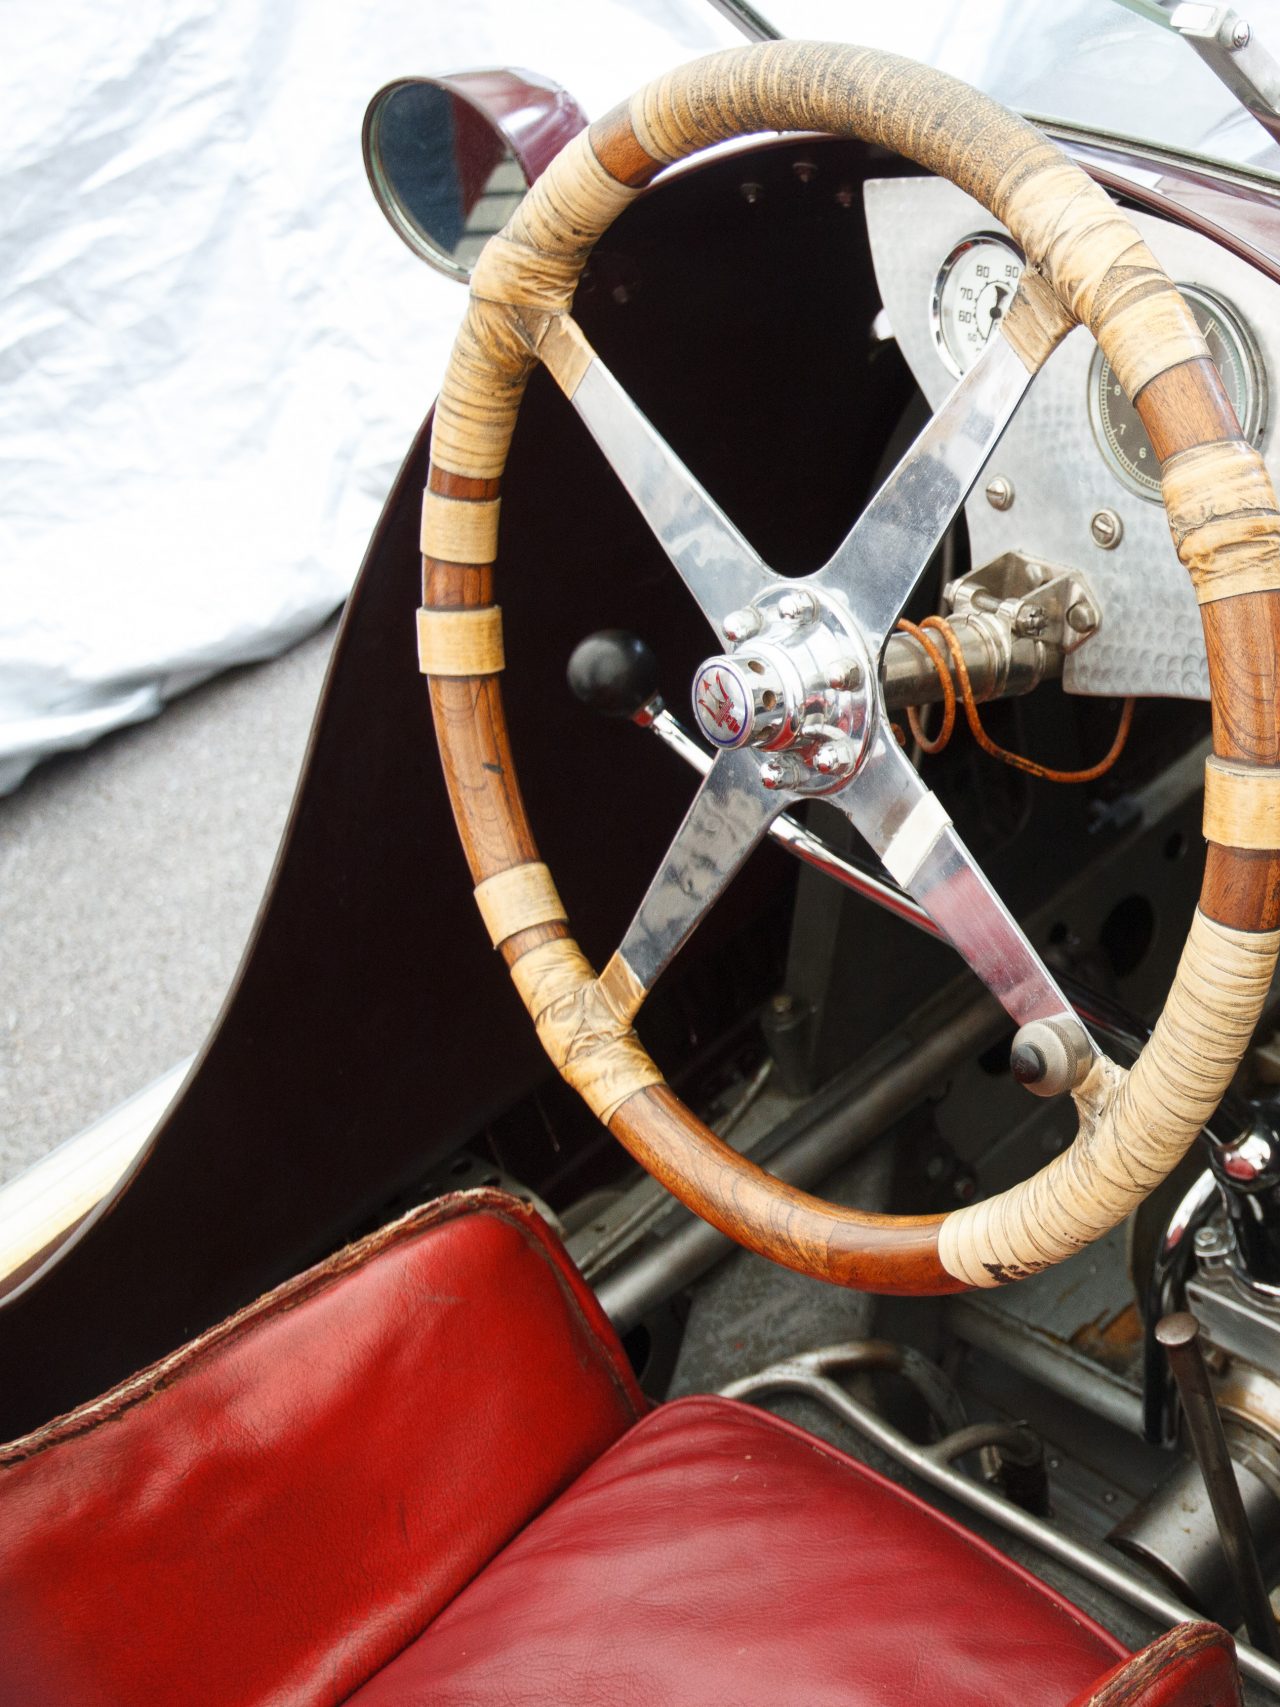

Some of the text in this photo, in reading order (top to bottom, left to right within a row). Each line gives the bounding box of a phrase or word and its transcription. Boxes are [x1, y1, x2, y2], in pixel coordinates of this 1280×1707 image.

[976, 264, 990, 278] 80
[1004, 264, 1019, 279] 90
[960, 287, 973, 301] 70
[958, 310, 972, 323] 60
[1113, 385, 1122, 396] 8
[1119, 423, 1127, 436] 7
[1138, 447, 1147, 459] 6
